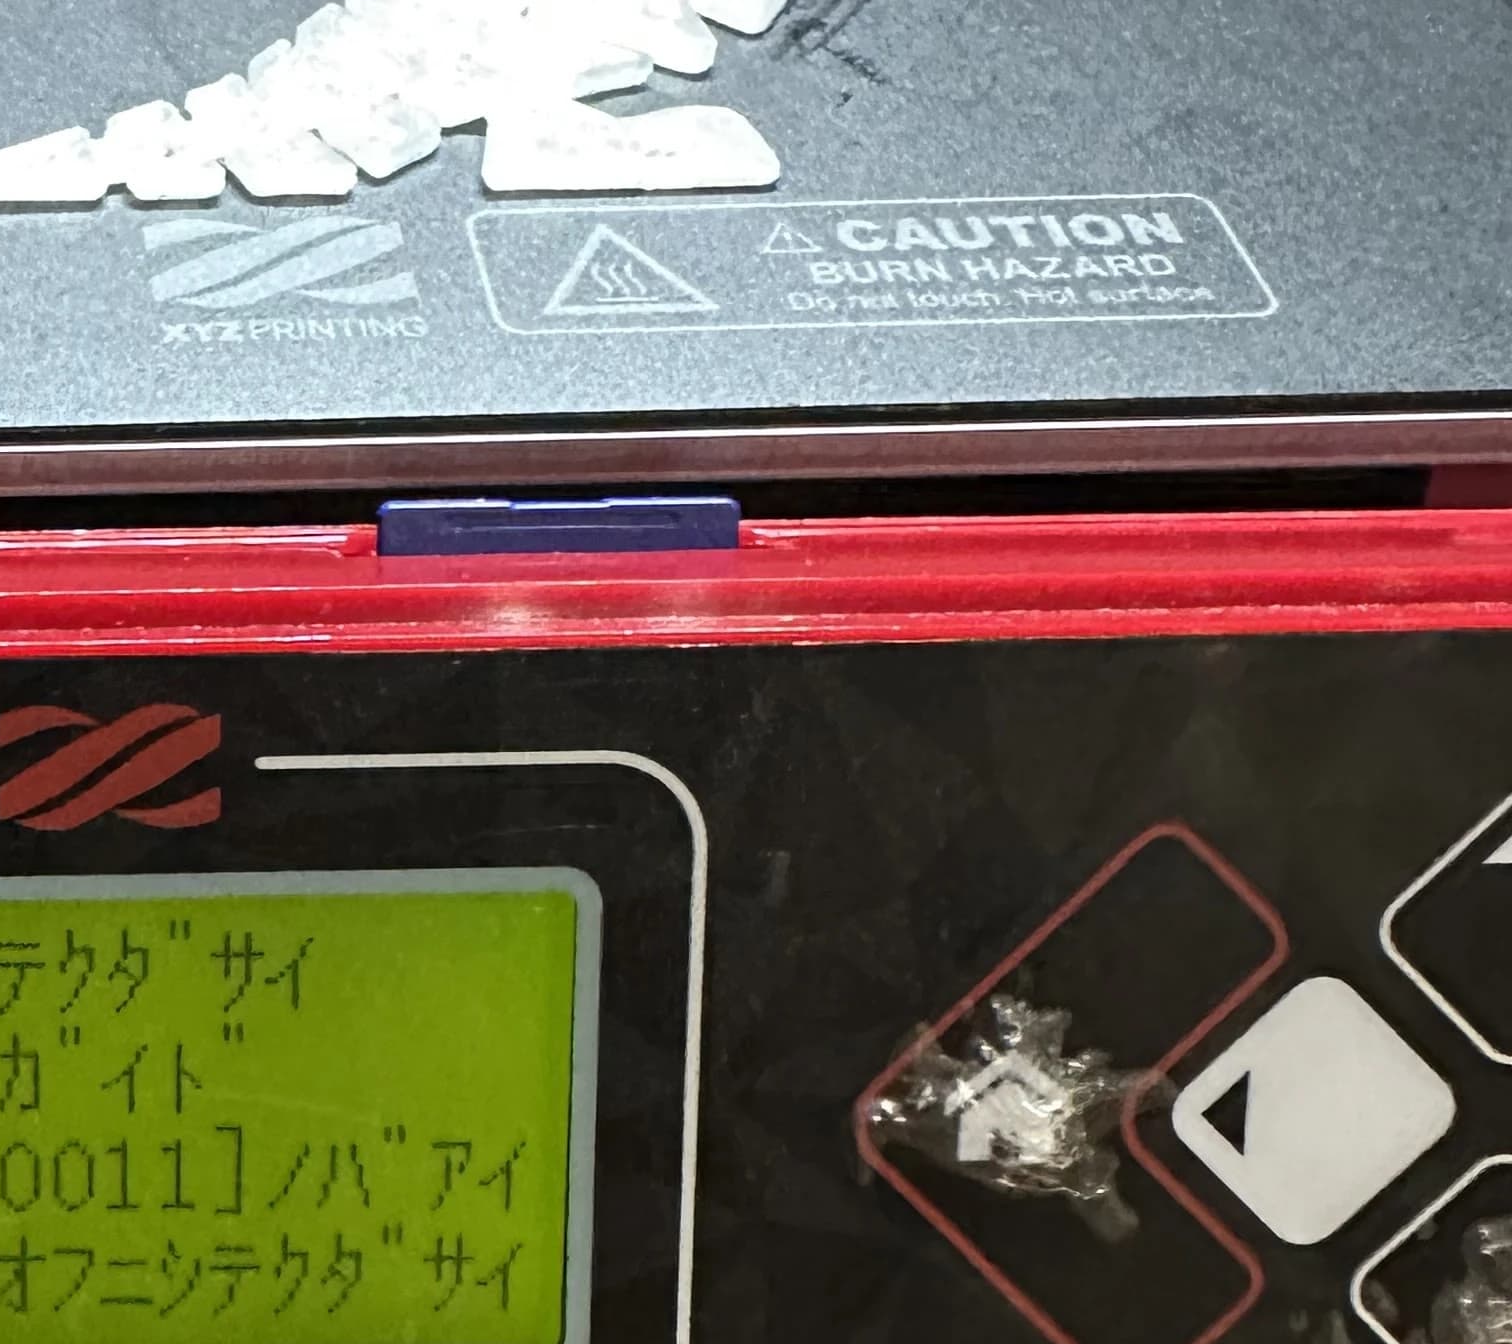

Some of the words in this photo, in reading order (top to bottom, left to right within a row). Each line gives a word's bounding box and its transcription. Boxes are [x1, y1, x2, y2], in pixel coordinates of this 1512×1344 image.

[836, 213, 1185, 252] CAUTION
[810, 257, 954, 285] BURN
[964, 254, 1178, 281] HAZARD
[160, 315, 429, 343] XYZPRINTING
